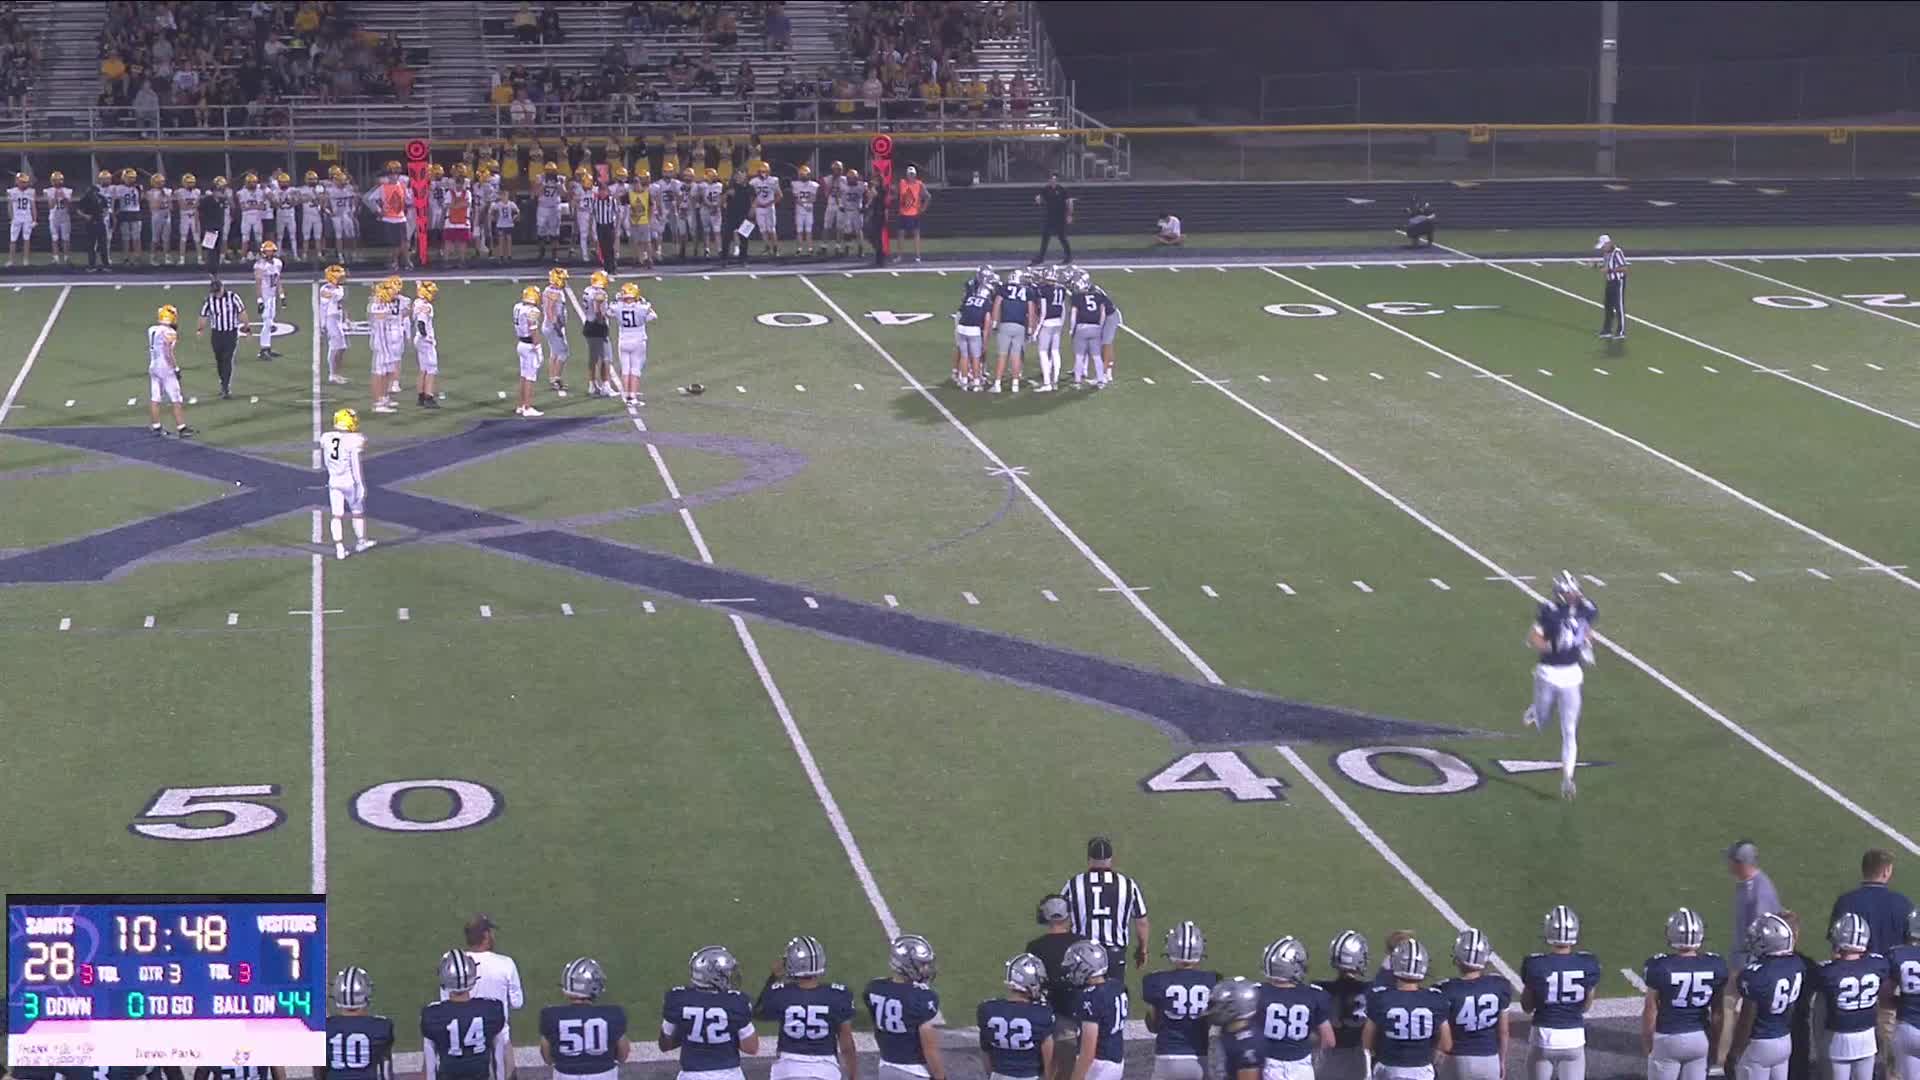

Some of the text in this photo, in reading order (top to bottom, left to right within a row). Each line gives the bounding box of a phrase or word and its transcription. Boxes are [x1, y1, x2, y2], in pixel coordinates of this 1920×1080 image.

[1007, 285, 1027, 301] 74
[1085, 295, 1097, 312] 5
[621, 310, 638, 328] 51
[330, 437, 341, 461] 3
[1092, 886, 1111, 916] L
[1545, 970, 1585, 1005] 15
[1670, 971, 1715, 1008] 75
[1768, 972, 1804, 1015] 64
[1836, 973, 1882, 1012] 22
[682, 1006, 731, 1044] 72
[783, 1005, 829, 1040] 65
[868, 993, 907, 1034] 78
[1263, 1002, 1310, 1041] 68
[1385, 1006, 1433, 1041] 30
[1455, 993, 1500, 1032] 42
[328, 1032, 370, 1069] 10
[446, 1016, 486, 1056] 14
[558, 1018, 608, 1056] 50
[987, 1016, 1035, 1051] 32
